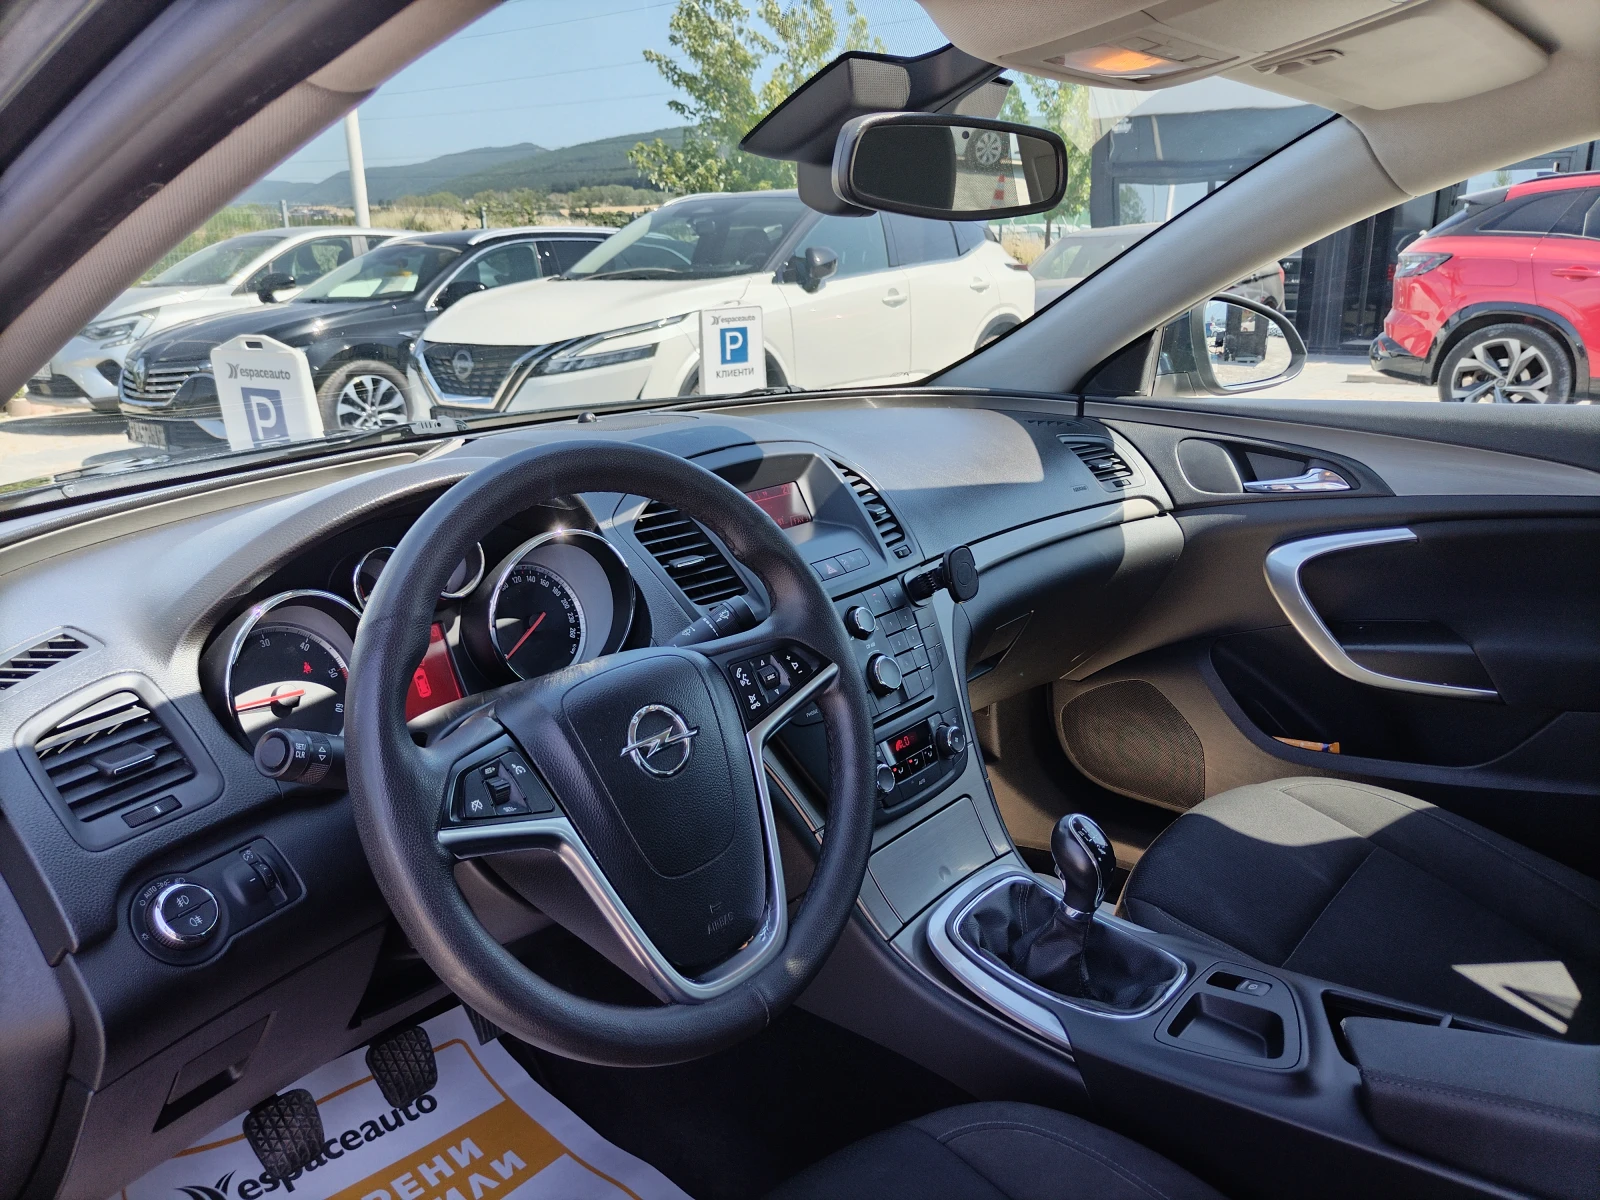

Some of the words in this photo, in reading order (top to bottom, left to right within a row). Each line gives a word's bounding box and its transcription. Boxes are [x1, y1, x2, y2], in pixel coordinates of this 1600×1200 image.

[721, 315, 756, 324] espaceauto
[725, 331, 743, 360] P
[240, 368, 291, 380] espaceauto
[716, 368, 755, 379] КЛИЕНТИ
[249, 395, 277, 440] P
[525, 575, 536, 583] 140
[260, 638, 271, 648] 30
[299, 642, 310, 652] 40
[328, 667, 338, 679] 50
[335, 702, 344, 713] 60
[143, 885, 158, 900] AUTO
